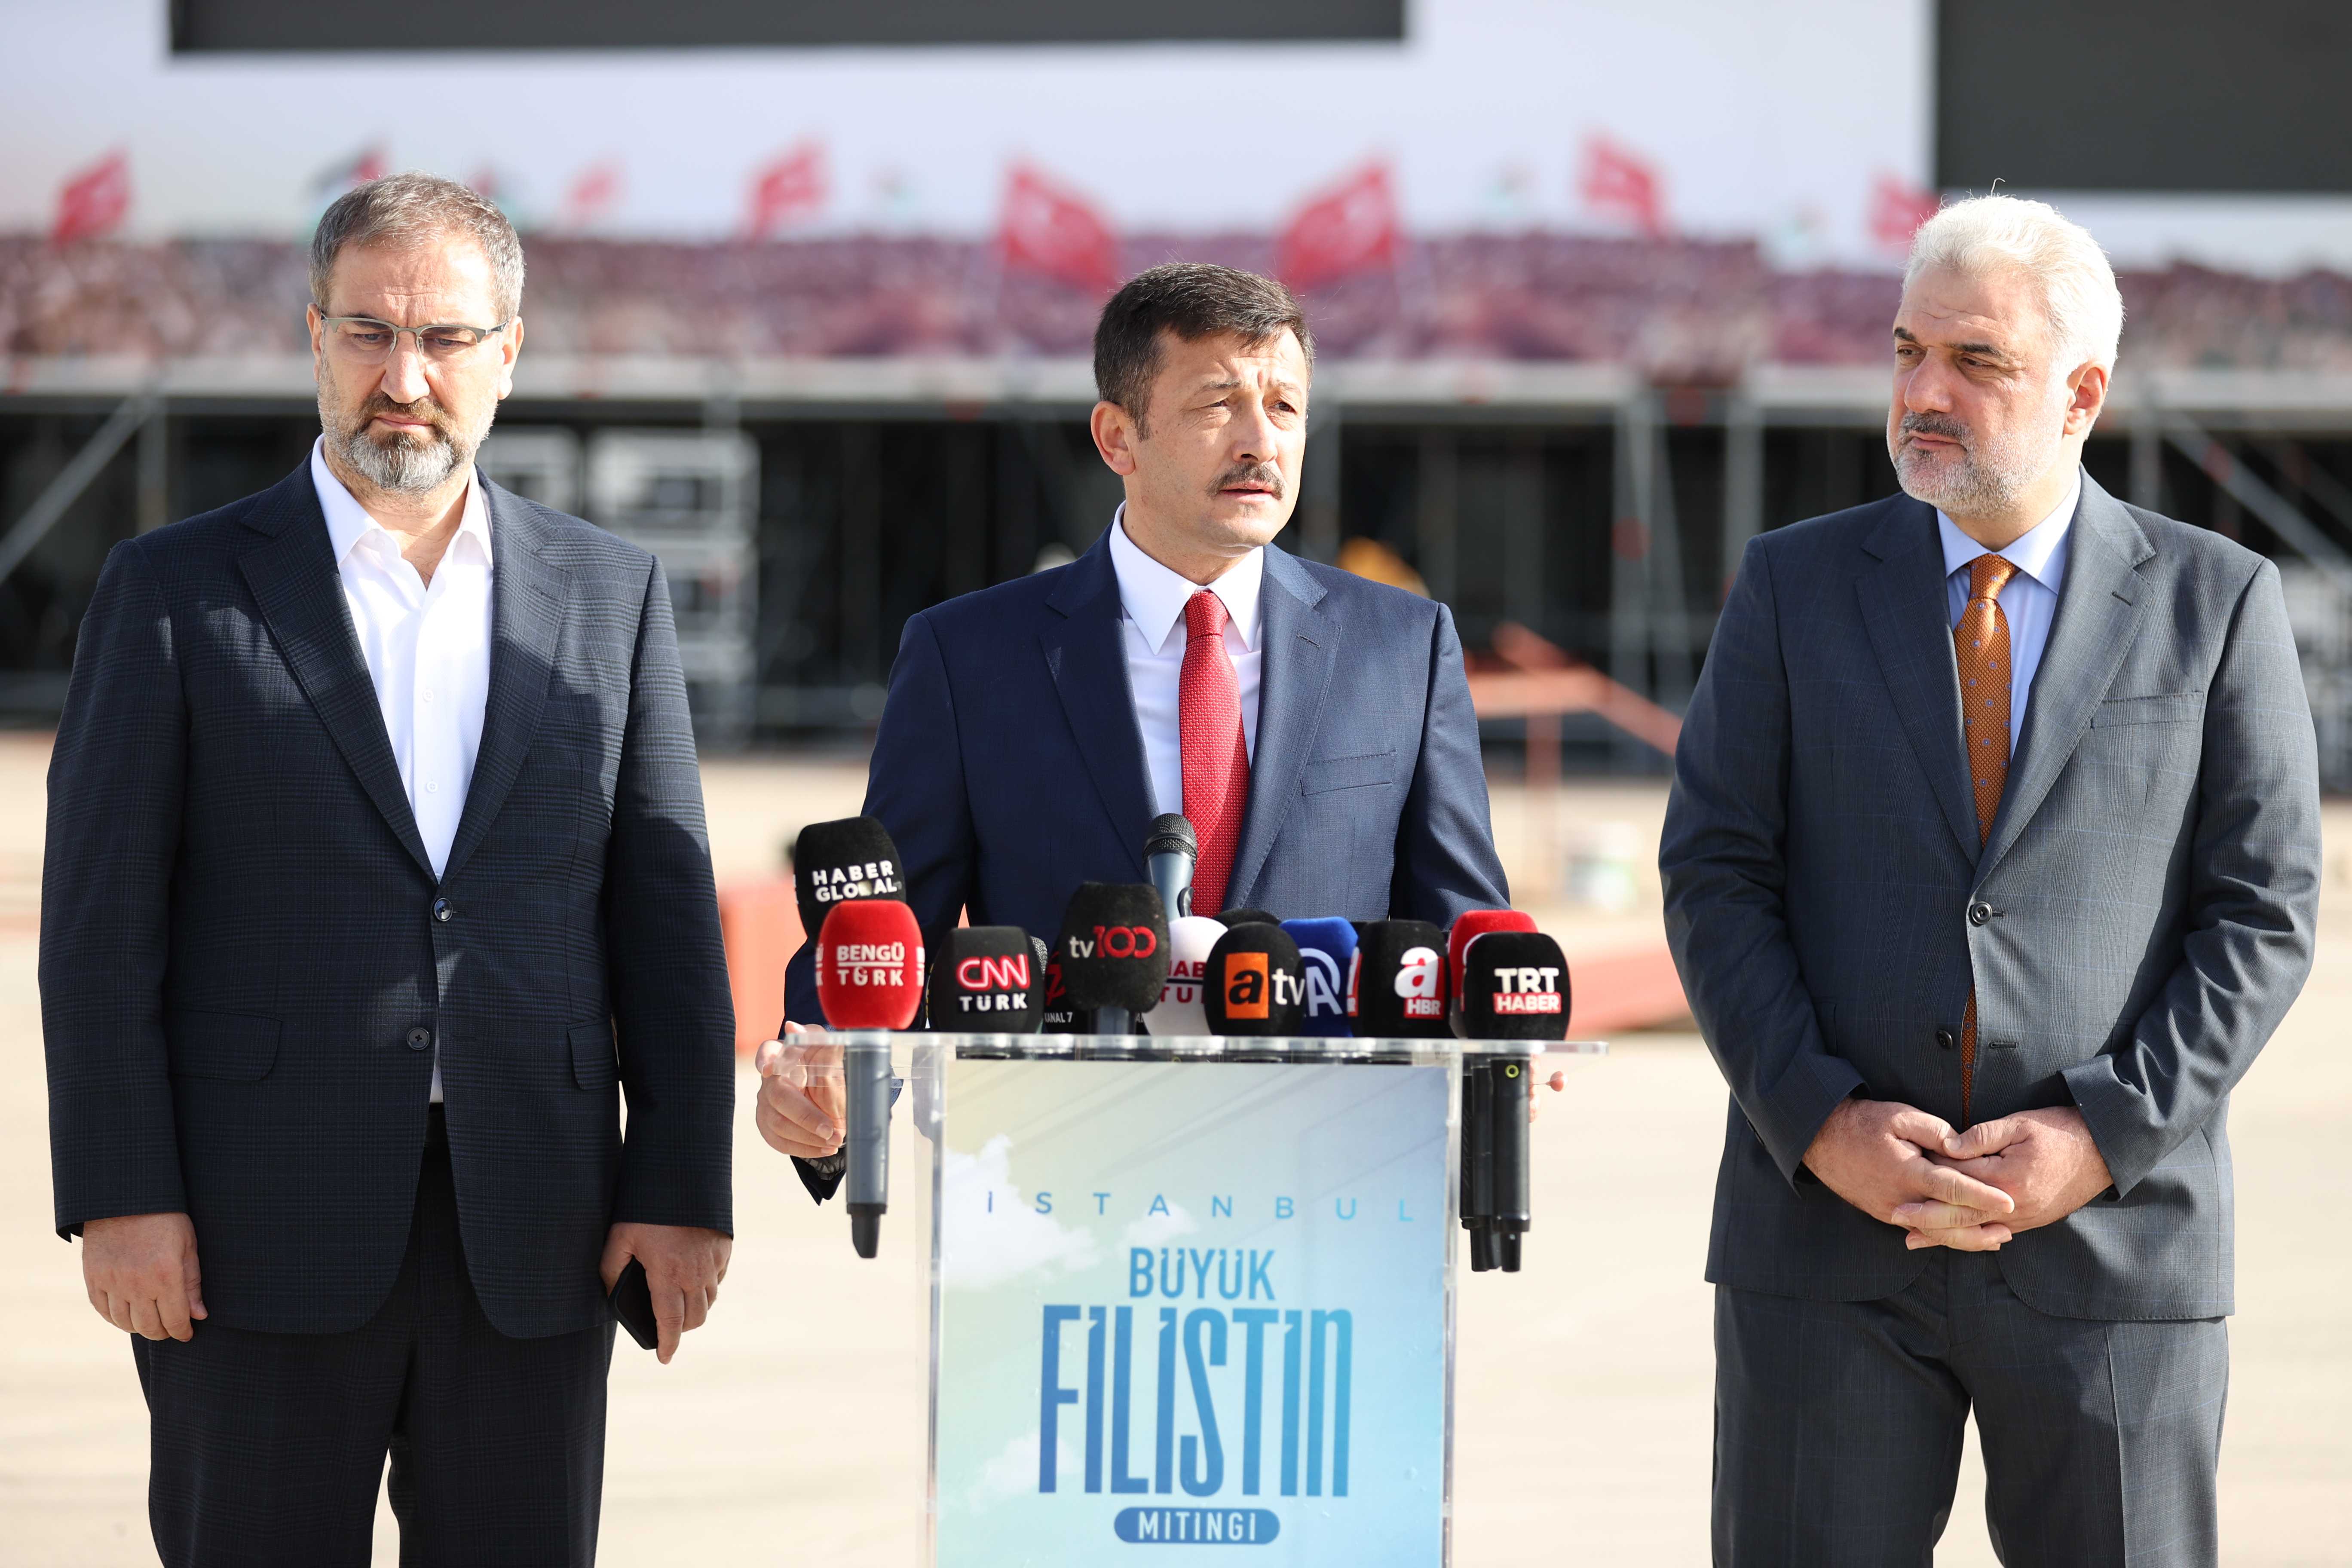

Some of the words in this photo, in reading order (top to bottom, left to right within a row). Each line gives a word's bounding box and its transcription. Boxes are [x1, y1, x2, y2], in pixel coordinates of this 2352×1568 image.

[812, 860, 894, 885] HABER
[836, 942, 905, 961] BENGÜ
[1069, 925, 1157, 959] tv100
[837, 966, 903, 986] TÜRK
[956, 954, 1030, 991] CNN
[1494, 967, 1559, 994] TRT
[1228, 968, 1305, 1006] atv
[959, 992, 1028, 1012] TÜRK
[1406, 999, 1441, 1015] HBR
[1497, 994, 1559, 1011] HABER
[1128, 1246, 1276, 1301] BÜYÜK
